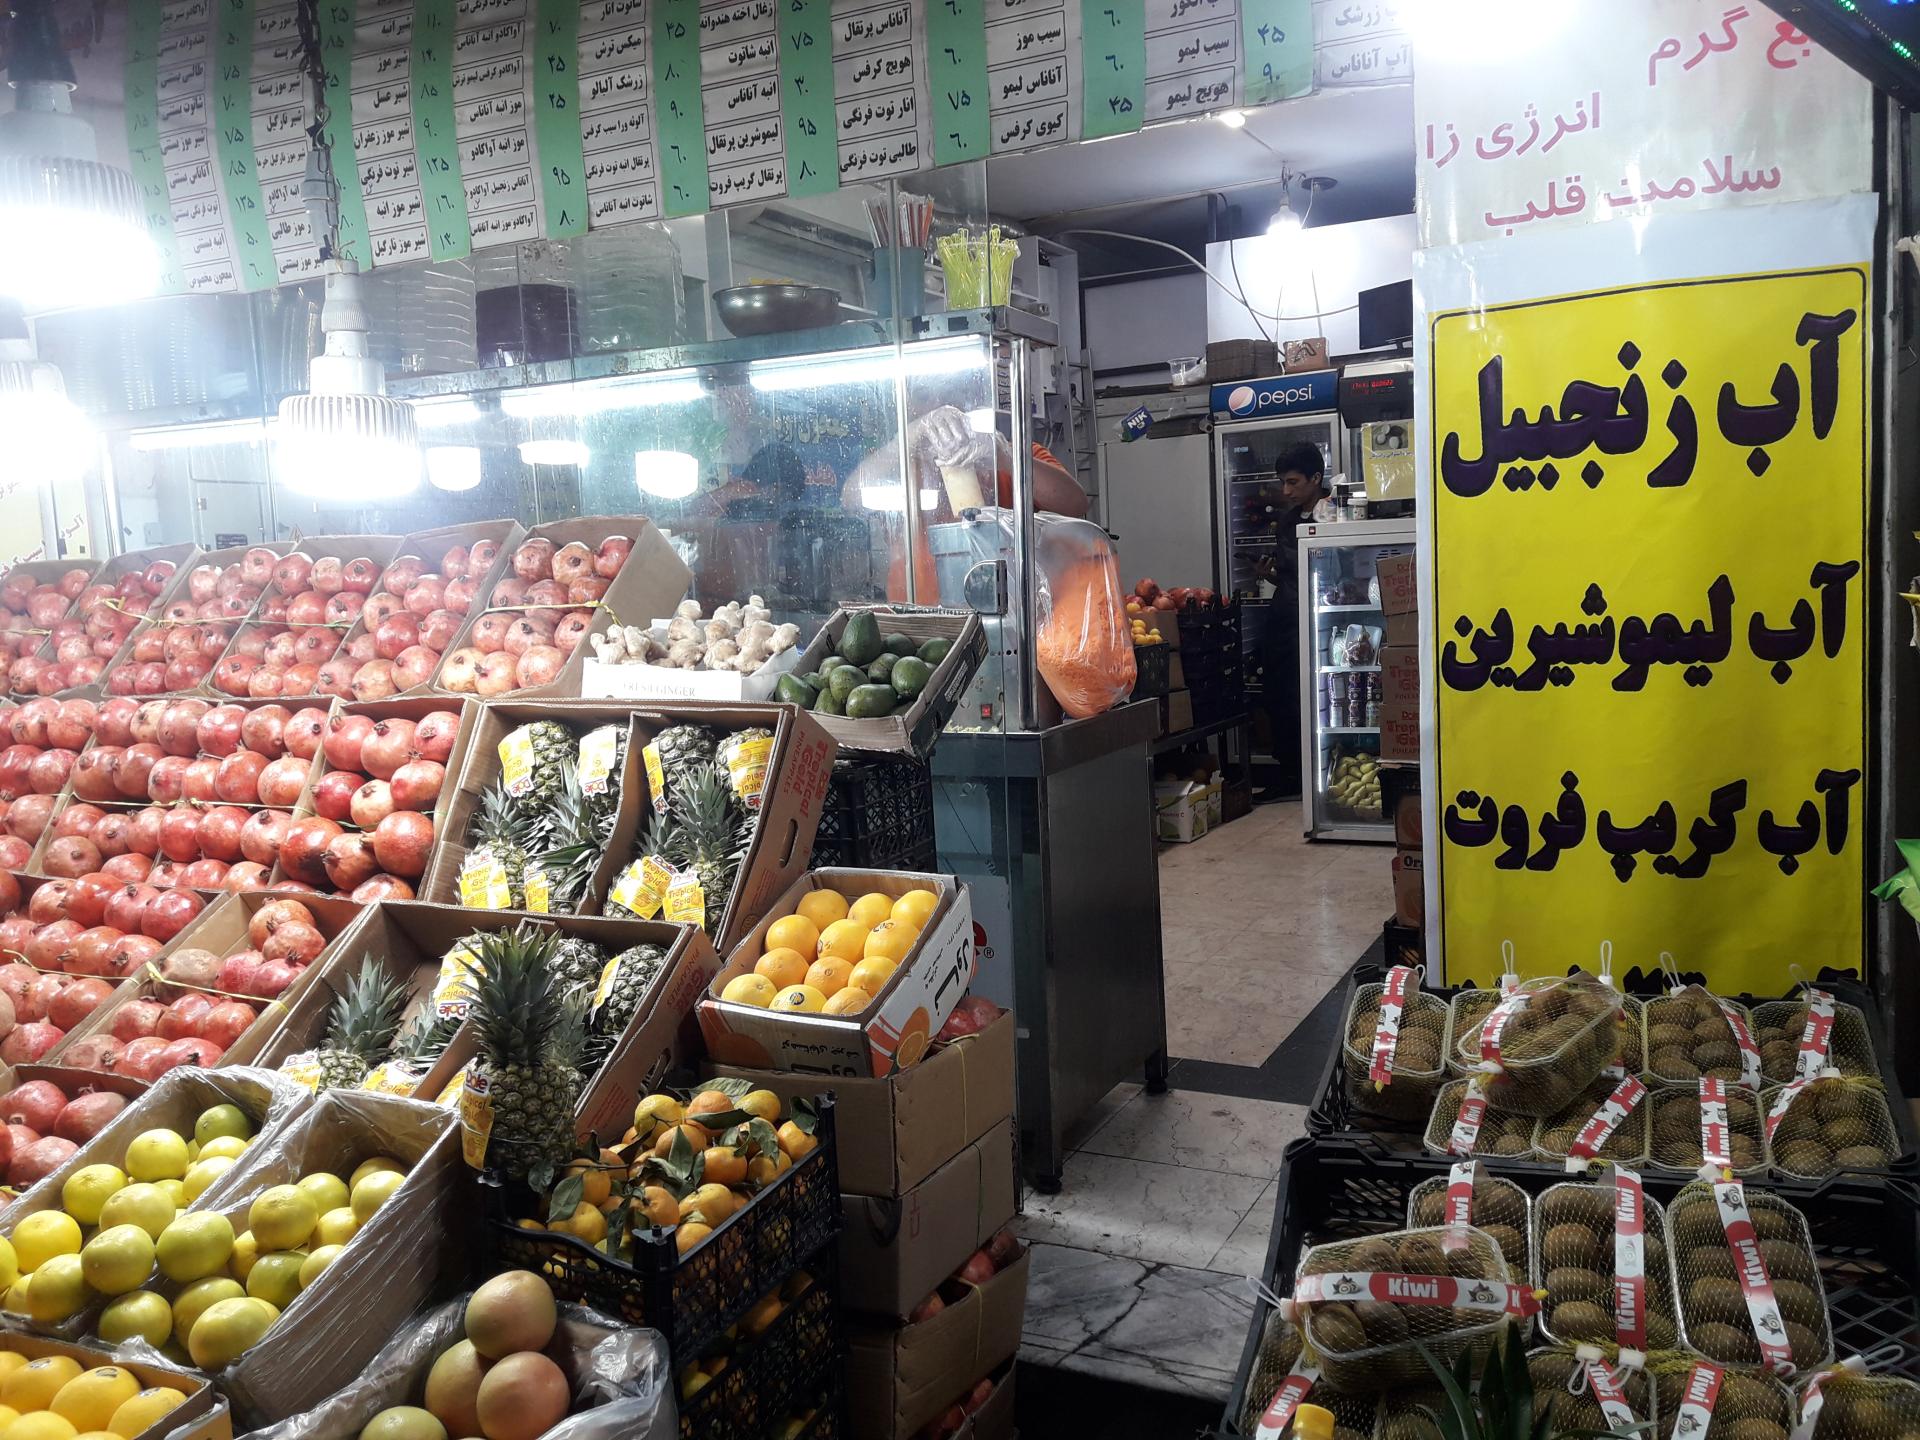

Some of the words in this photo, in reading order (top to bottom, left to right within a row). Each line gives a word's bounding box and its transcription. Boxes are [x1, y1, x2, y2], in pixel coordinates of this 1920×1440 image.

[1016, 32, 1034, 50] موز
[1178, 38, 1200, 63] لیمو
[1203, 39, 1229, 56] سیب
[1648, 5, 1750, 87] گرم
[948, 90, 970, 110] ۷۵
[1026, 65, 1062, 94] آناناس
[1474, 91, 1600, 160] انرژی
[1484, 174, 1586, 236] قلب
[1604, 154, 1782, 208] سلامت
[1258, 384, 1312, 408] pepsi
[1717, 308, 1857, 477] آب
[1127, 410, 1148, 430] NIK
[1440, 340, 1699, 498] زنجبیل
[1748, 560, 1860, 685] آب
[1443, 770, 1586, 870] فروت
[1757, 768, 1860, 876] آب
[1388, 1278, 1438, 1298] Kiwi
[1734, 1238, 1767, 1288] Kiwi
